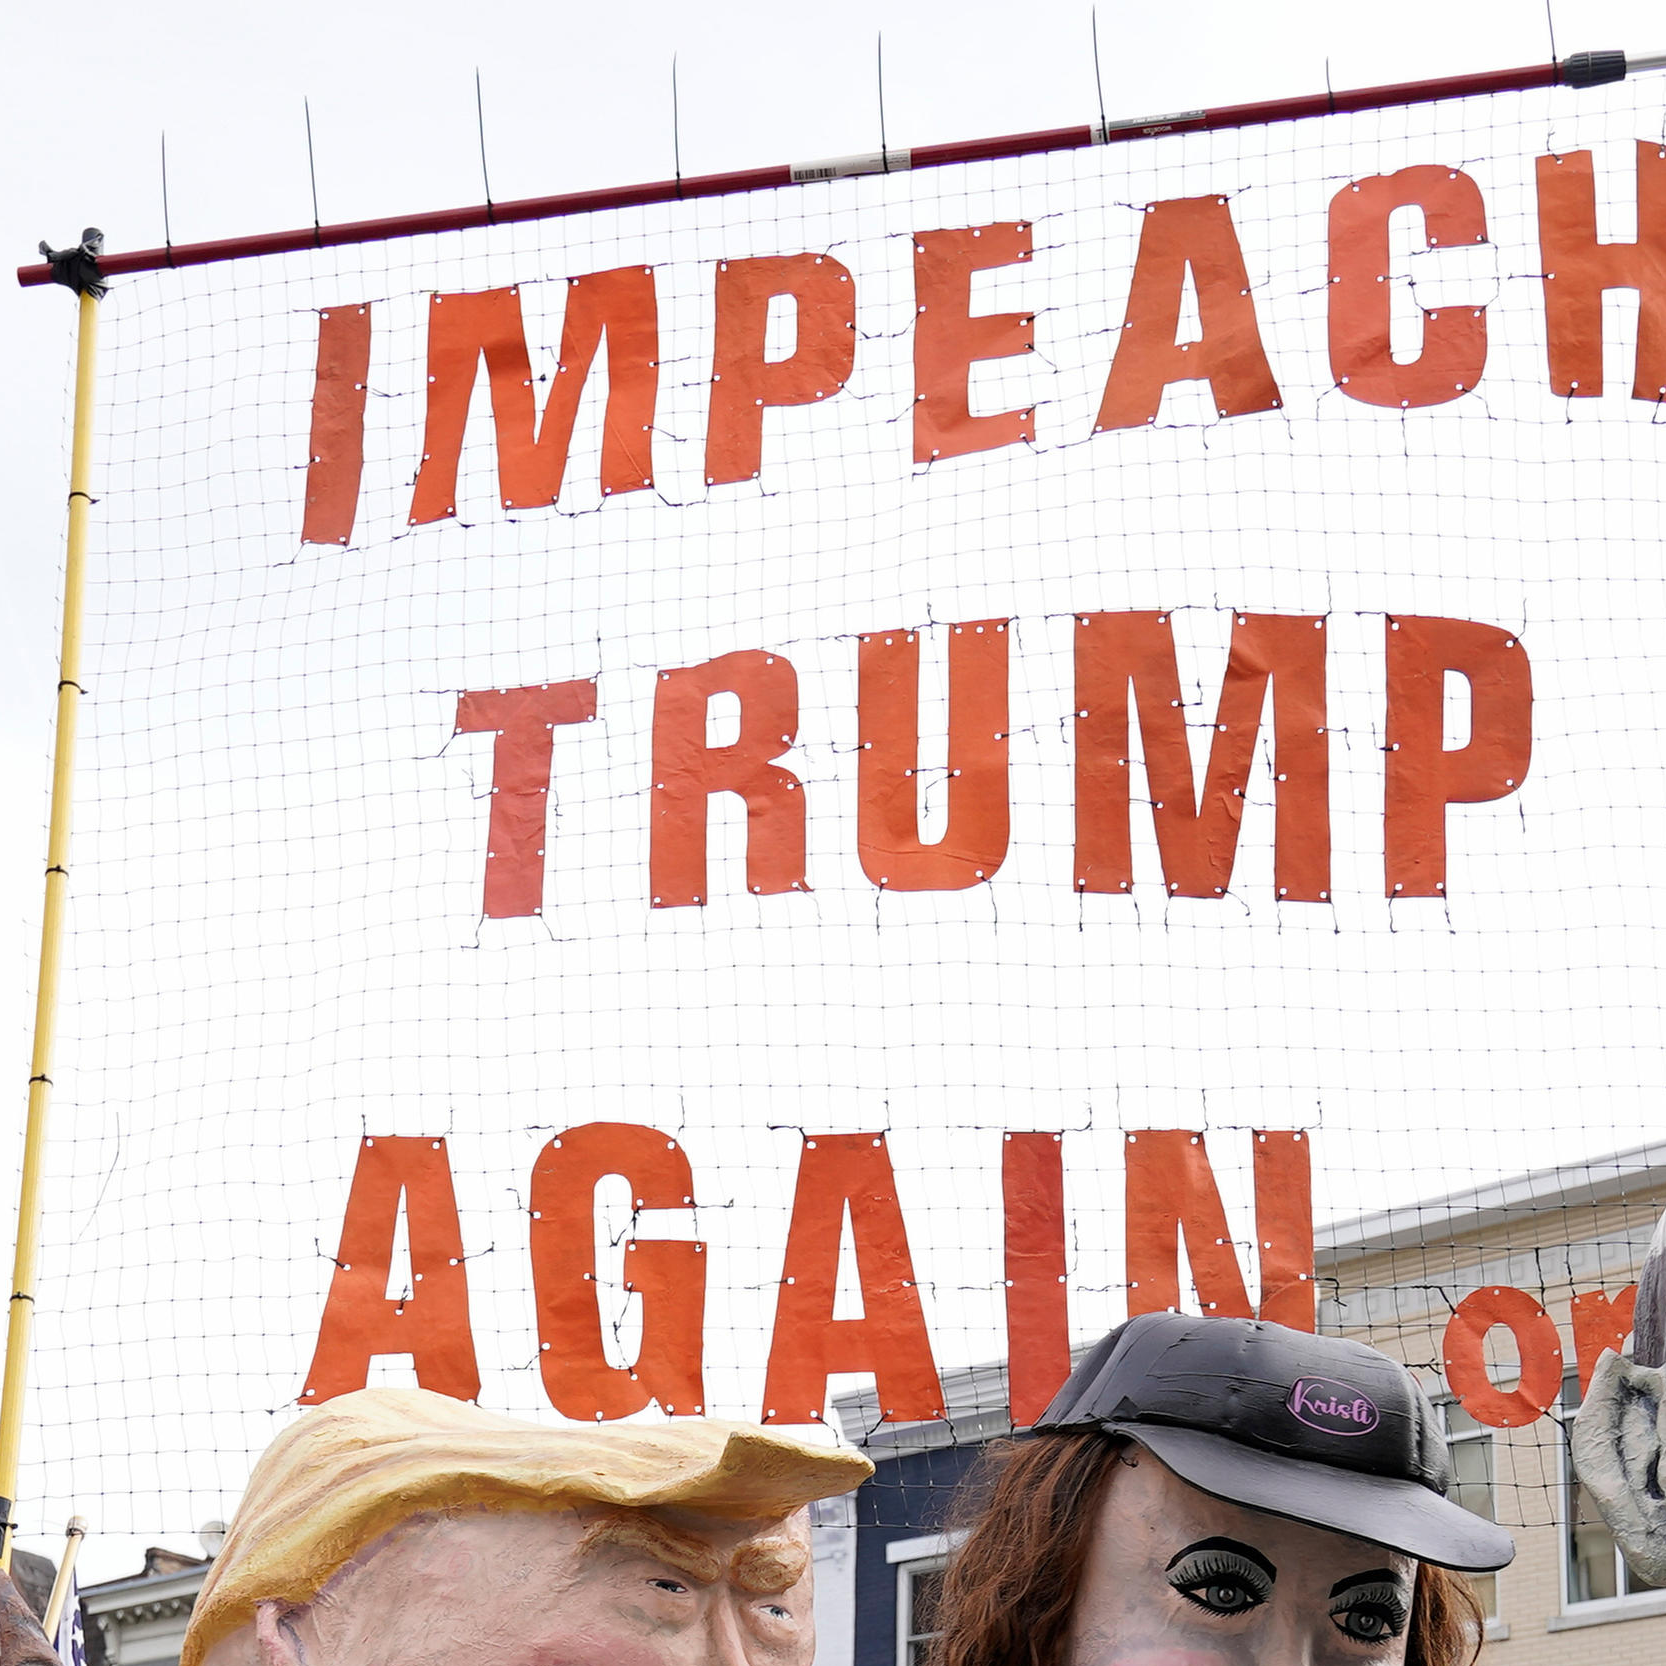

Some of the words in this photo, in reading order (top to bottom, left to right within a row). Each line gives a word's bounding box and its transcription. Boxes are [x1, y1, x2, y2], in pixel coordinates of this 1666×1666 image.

[457, 611, 1532, 917] TRUMP
[298, 1122, 1315, 1425] AGAIN
[1293, 1380, 1373, 1424] Kristi
